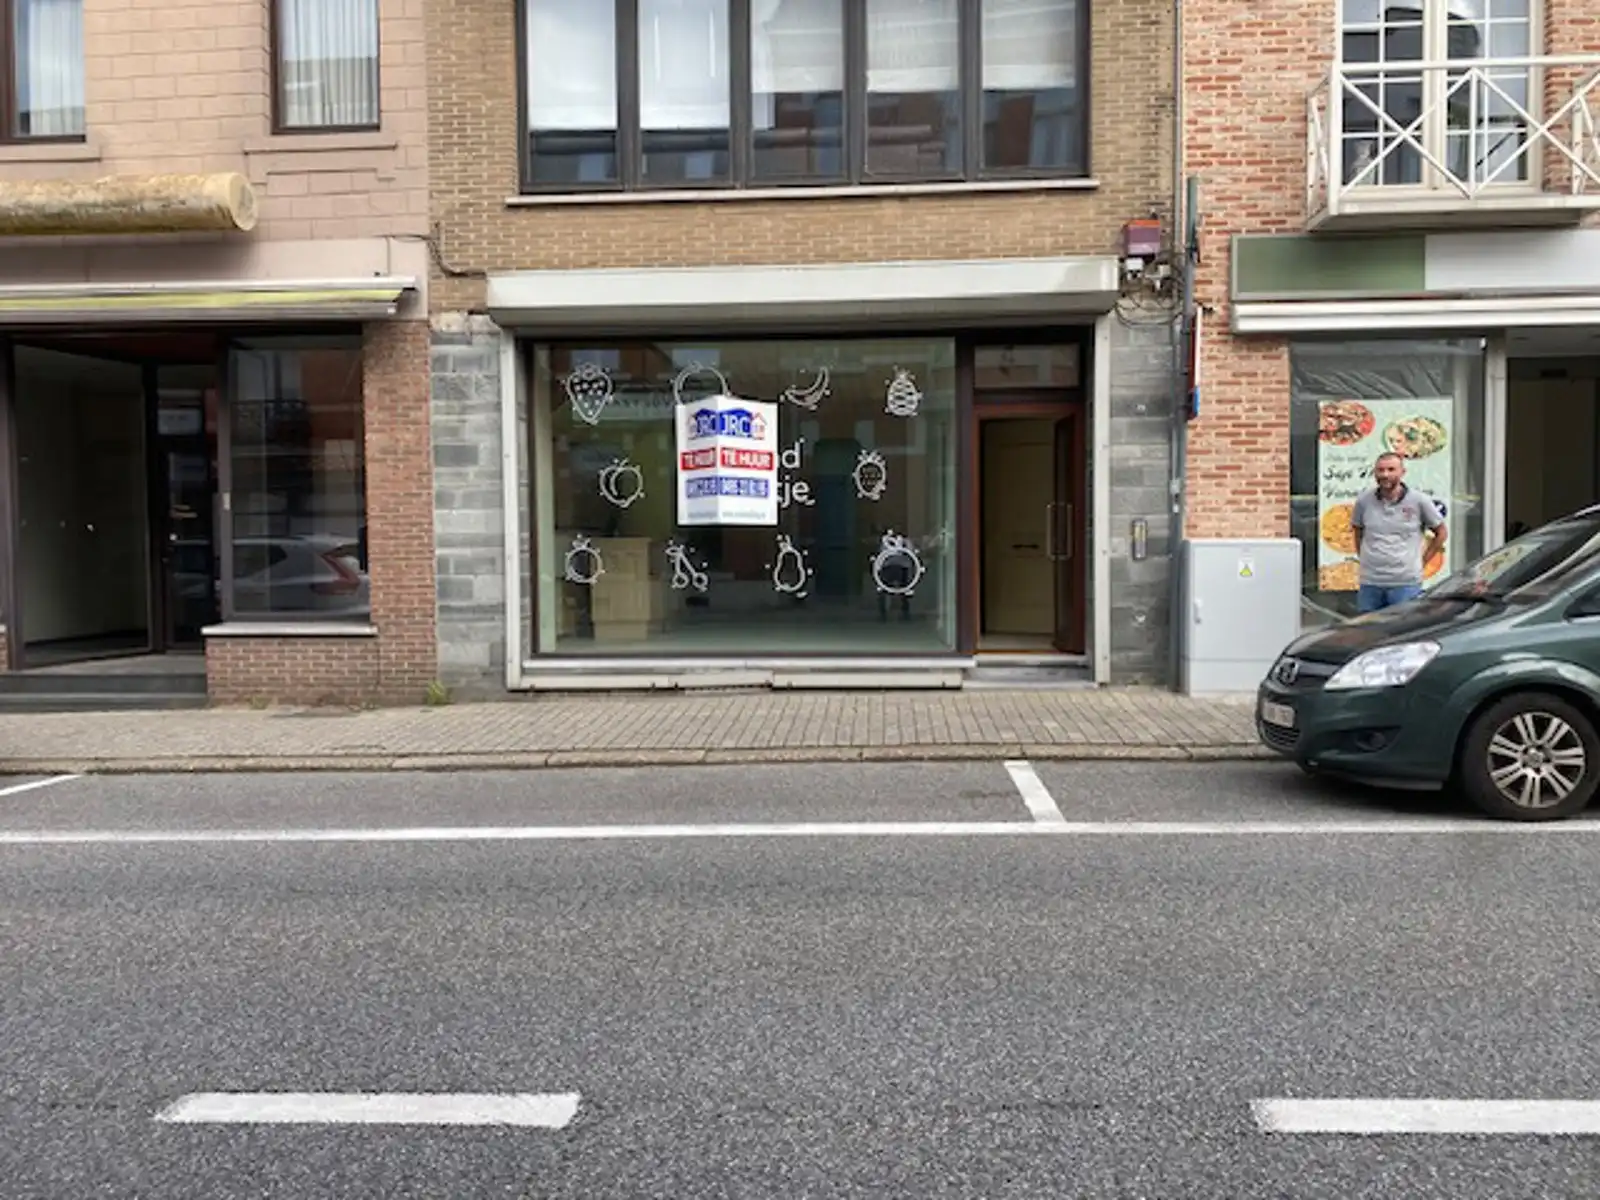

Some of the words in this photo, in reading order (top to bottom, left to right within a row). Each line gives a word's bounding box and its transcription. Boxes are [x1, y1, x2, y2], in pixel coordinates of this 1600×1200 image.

[723, 414, 752, 437] JRC
[723, 449, 737, 466] TE
[740, 452, 770, 469] HUUR
[776, 441, 800, 468] d
